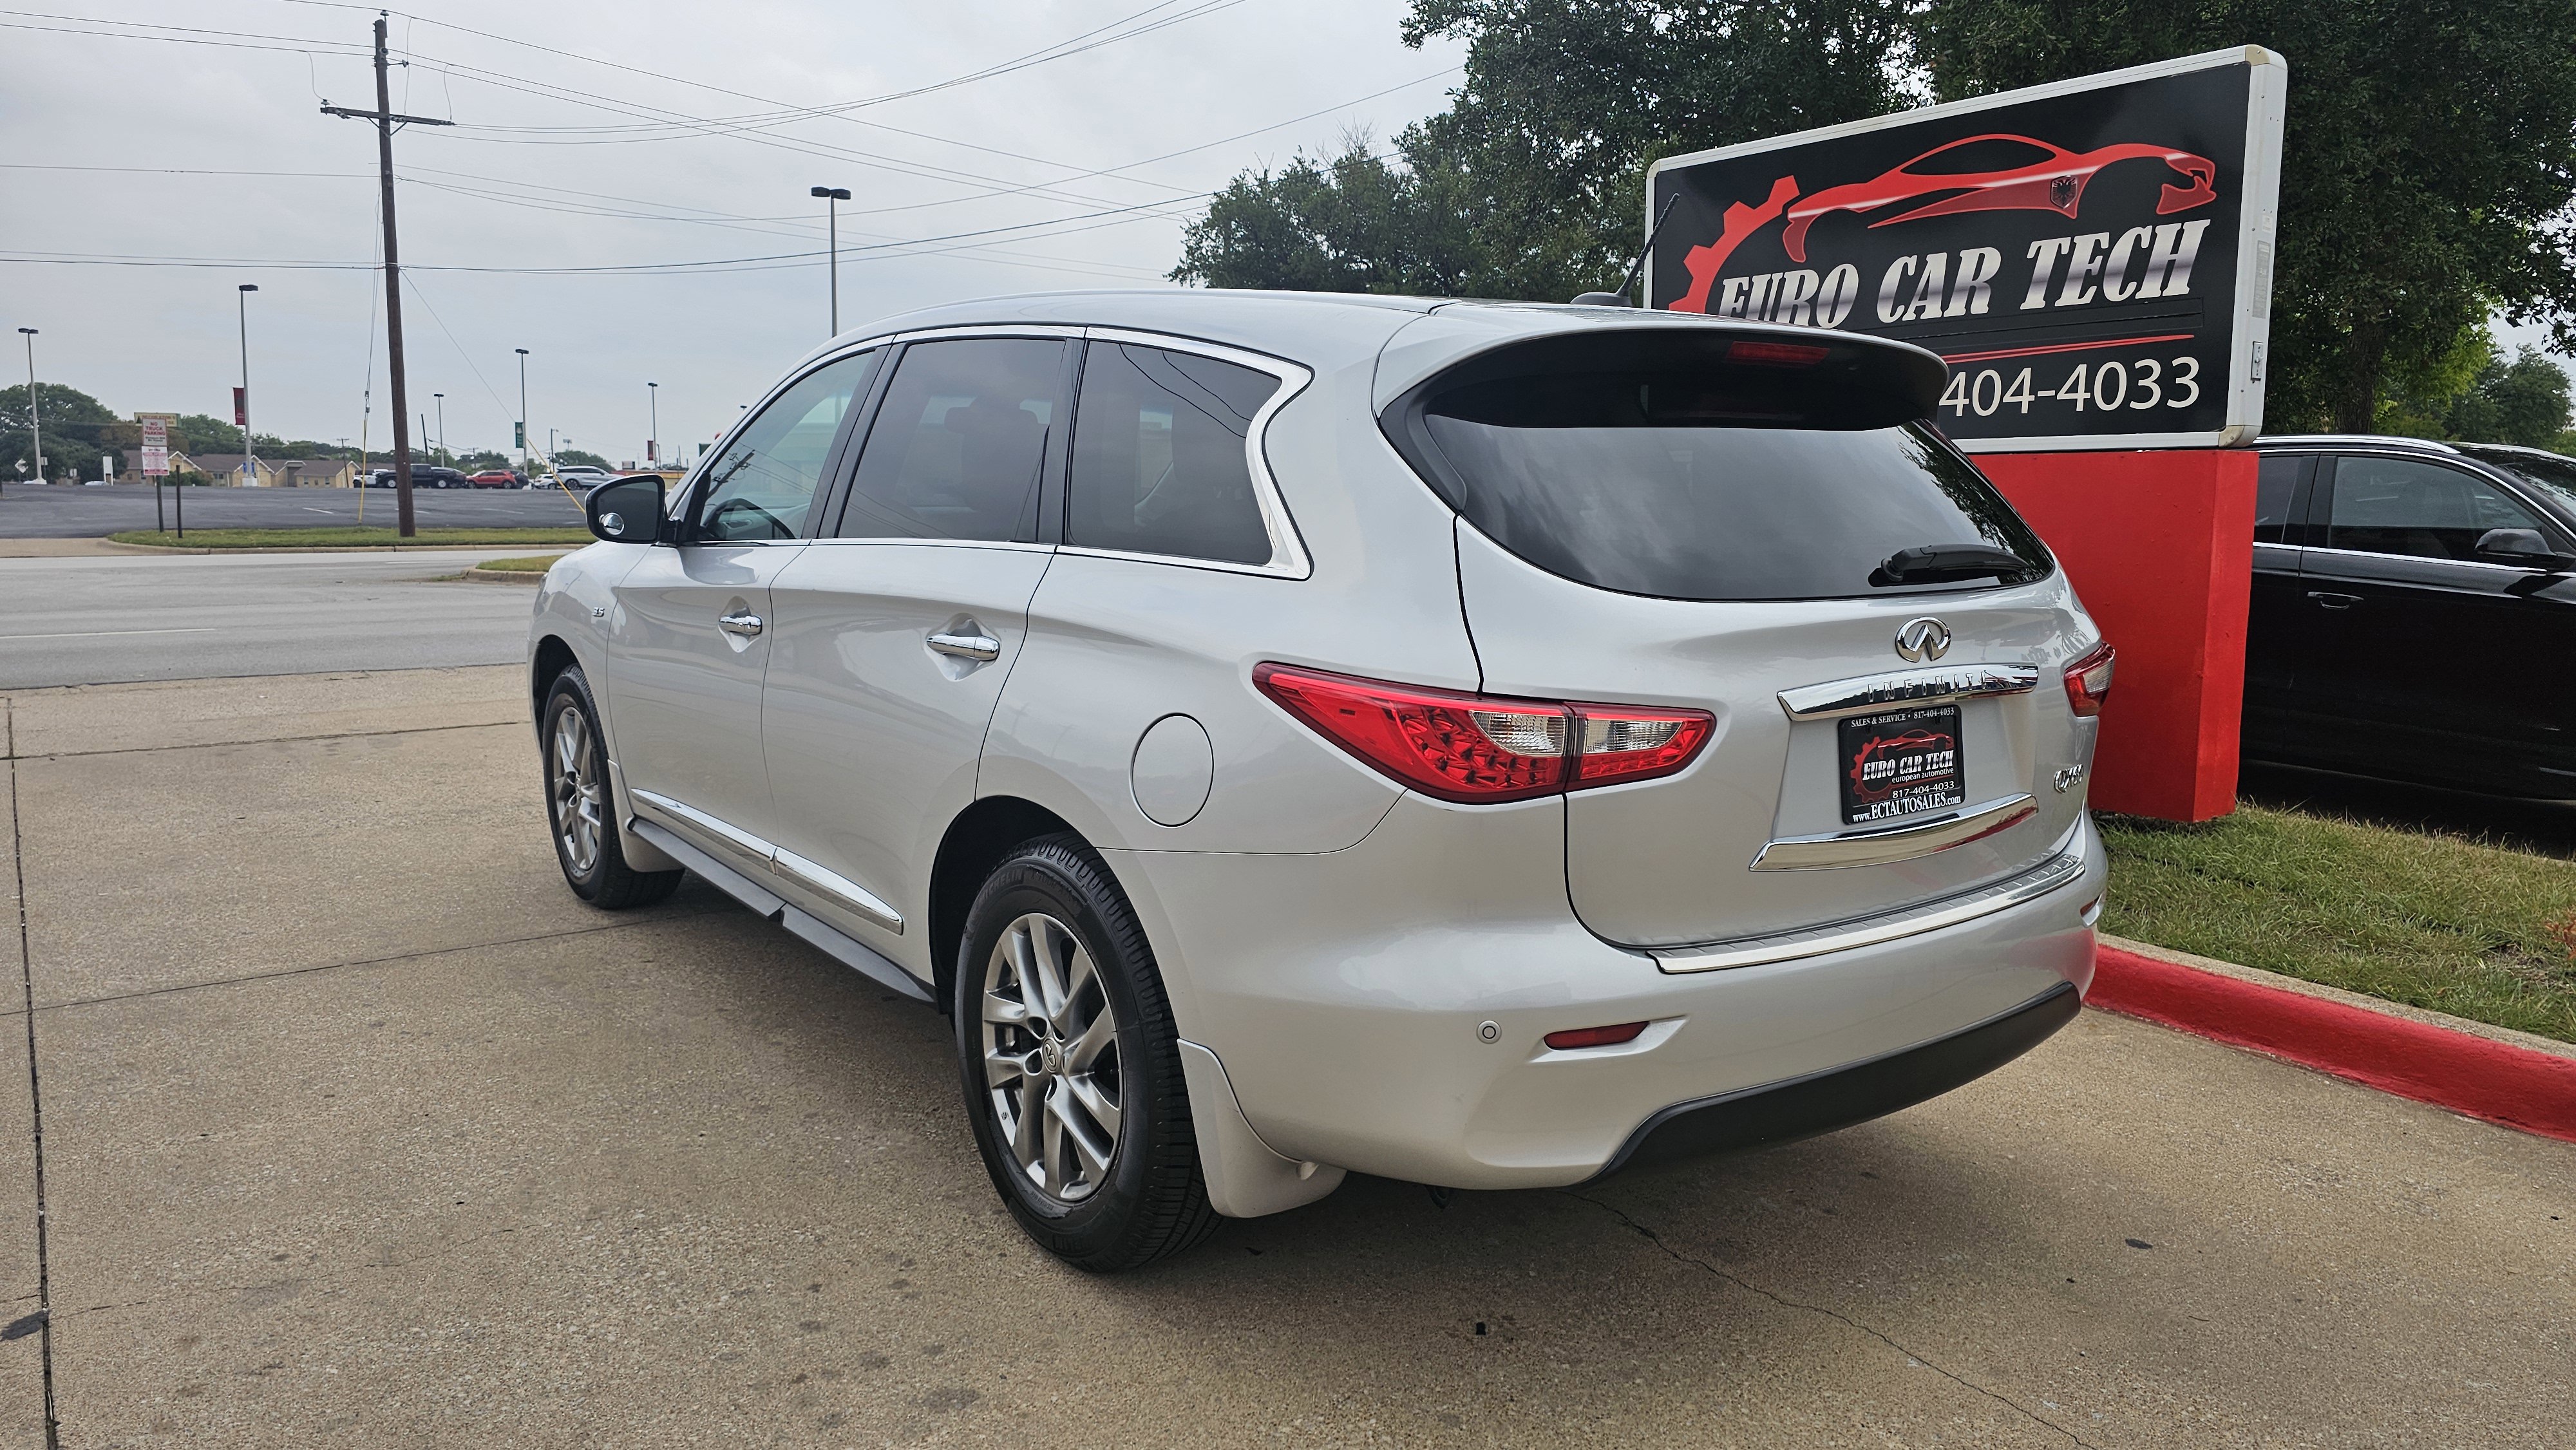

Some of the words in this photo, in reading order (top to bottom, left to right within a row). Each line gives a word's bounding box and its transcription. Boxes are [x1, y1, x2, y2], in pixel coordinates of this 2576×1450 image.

[1719, 263, 1859, 329] EURO
[1877, 247, 2002, 323] CAR
[2020, 219, 2211, 310] TECH
[1938, 356, 2200, 417] 404-4033
[1868, 672, 1986, 702] INFINITI
[1851, 717, 1870, 728] SALES
[1879, 713, 1906, 724] SERVICE
[1913, 707, 1955, 719] 817-404-4033
[1862, 758, 1896, 781] EURO
[1899, 755, 1923, 775] CAR
[1926, 750, 1954, 771] TECH
[1891, 773, 1920, 784] european
[1921, 767, 1954, 778] automotive
[1892, 780, 1955, 799] 817-404-4033
[1852, 791, 1962, 823] www.ECTAUTOSALES.com
